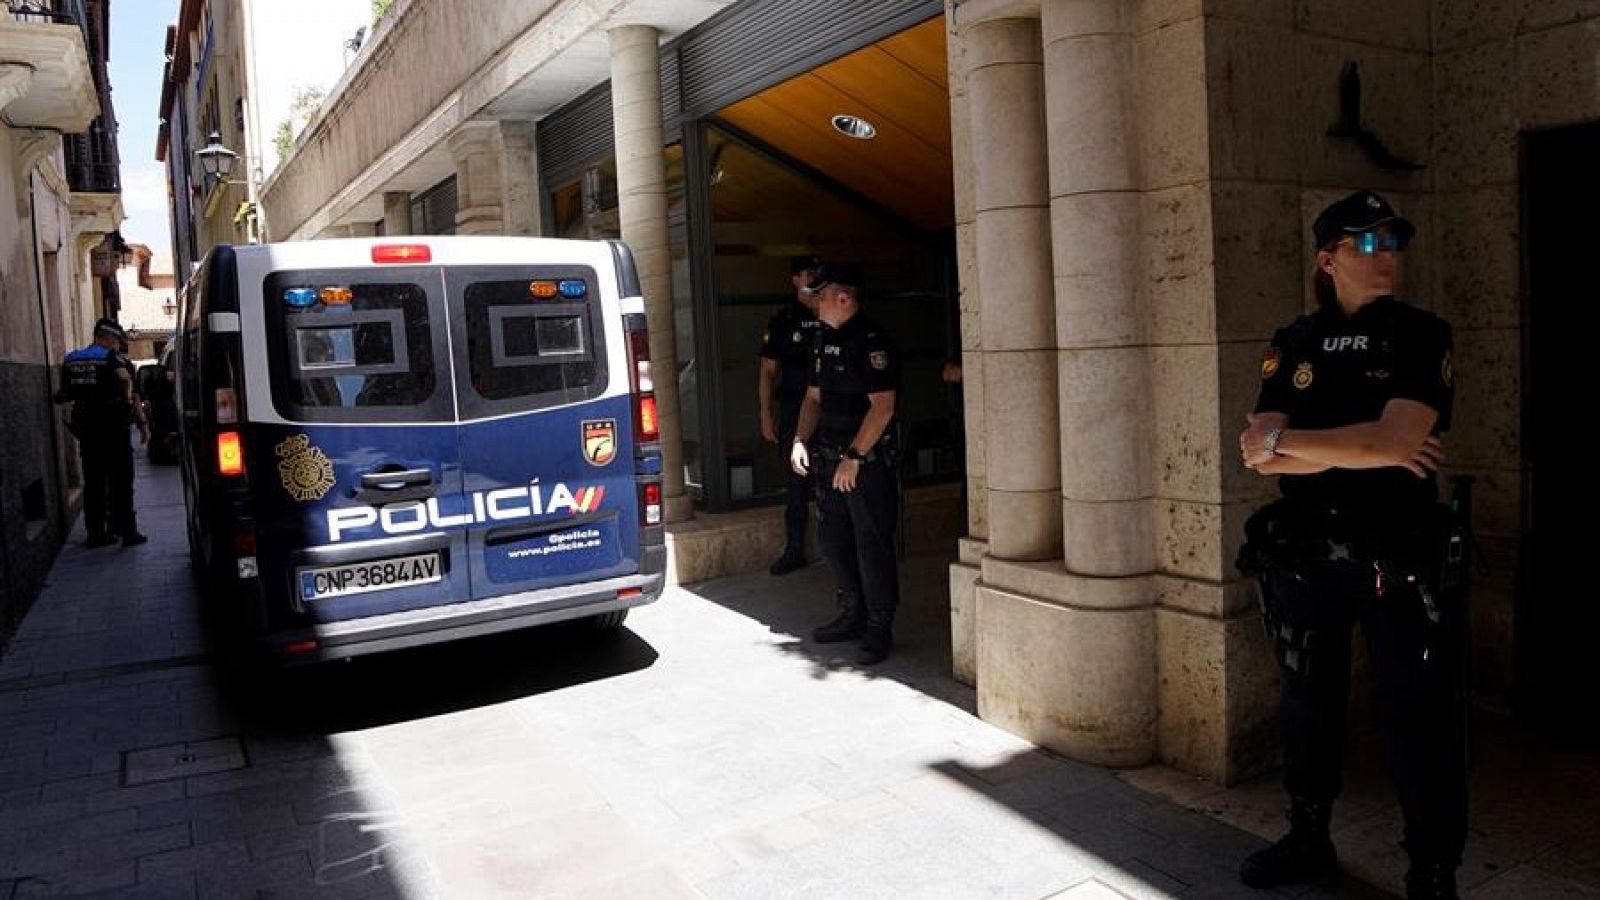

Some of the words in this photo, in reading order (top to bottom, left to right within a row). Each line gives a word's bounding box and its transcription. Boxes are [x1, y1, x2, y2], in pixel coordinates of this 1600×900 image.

[1322, 335, 1369, 351] UPR
[327, 478, 578, 541] POLICÍA
[508, 539, 601, 557] www.policia.es
